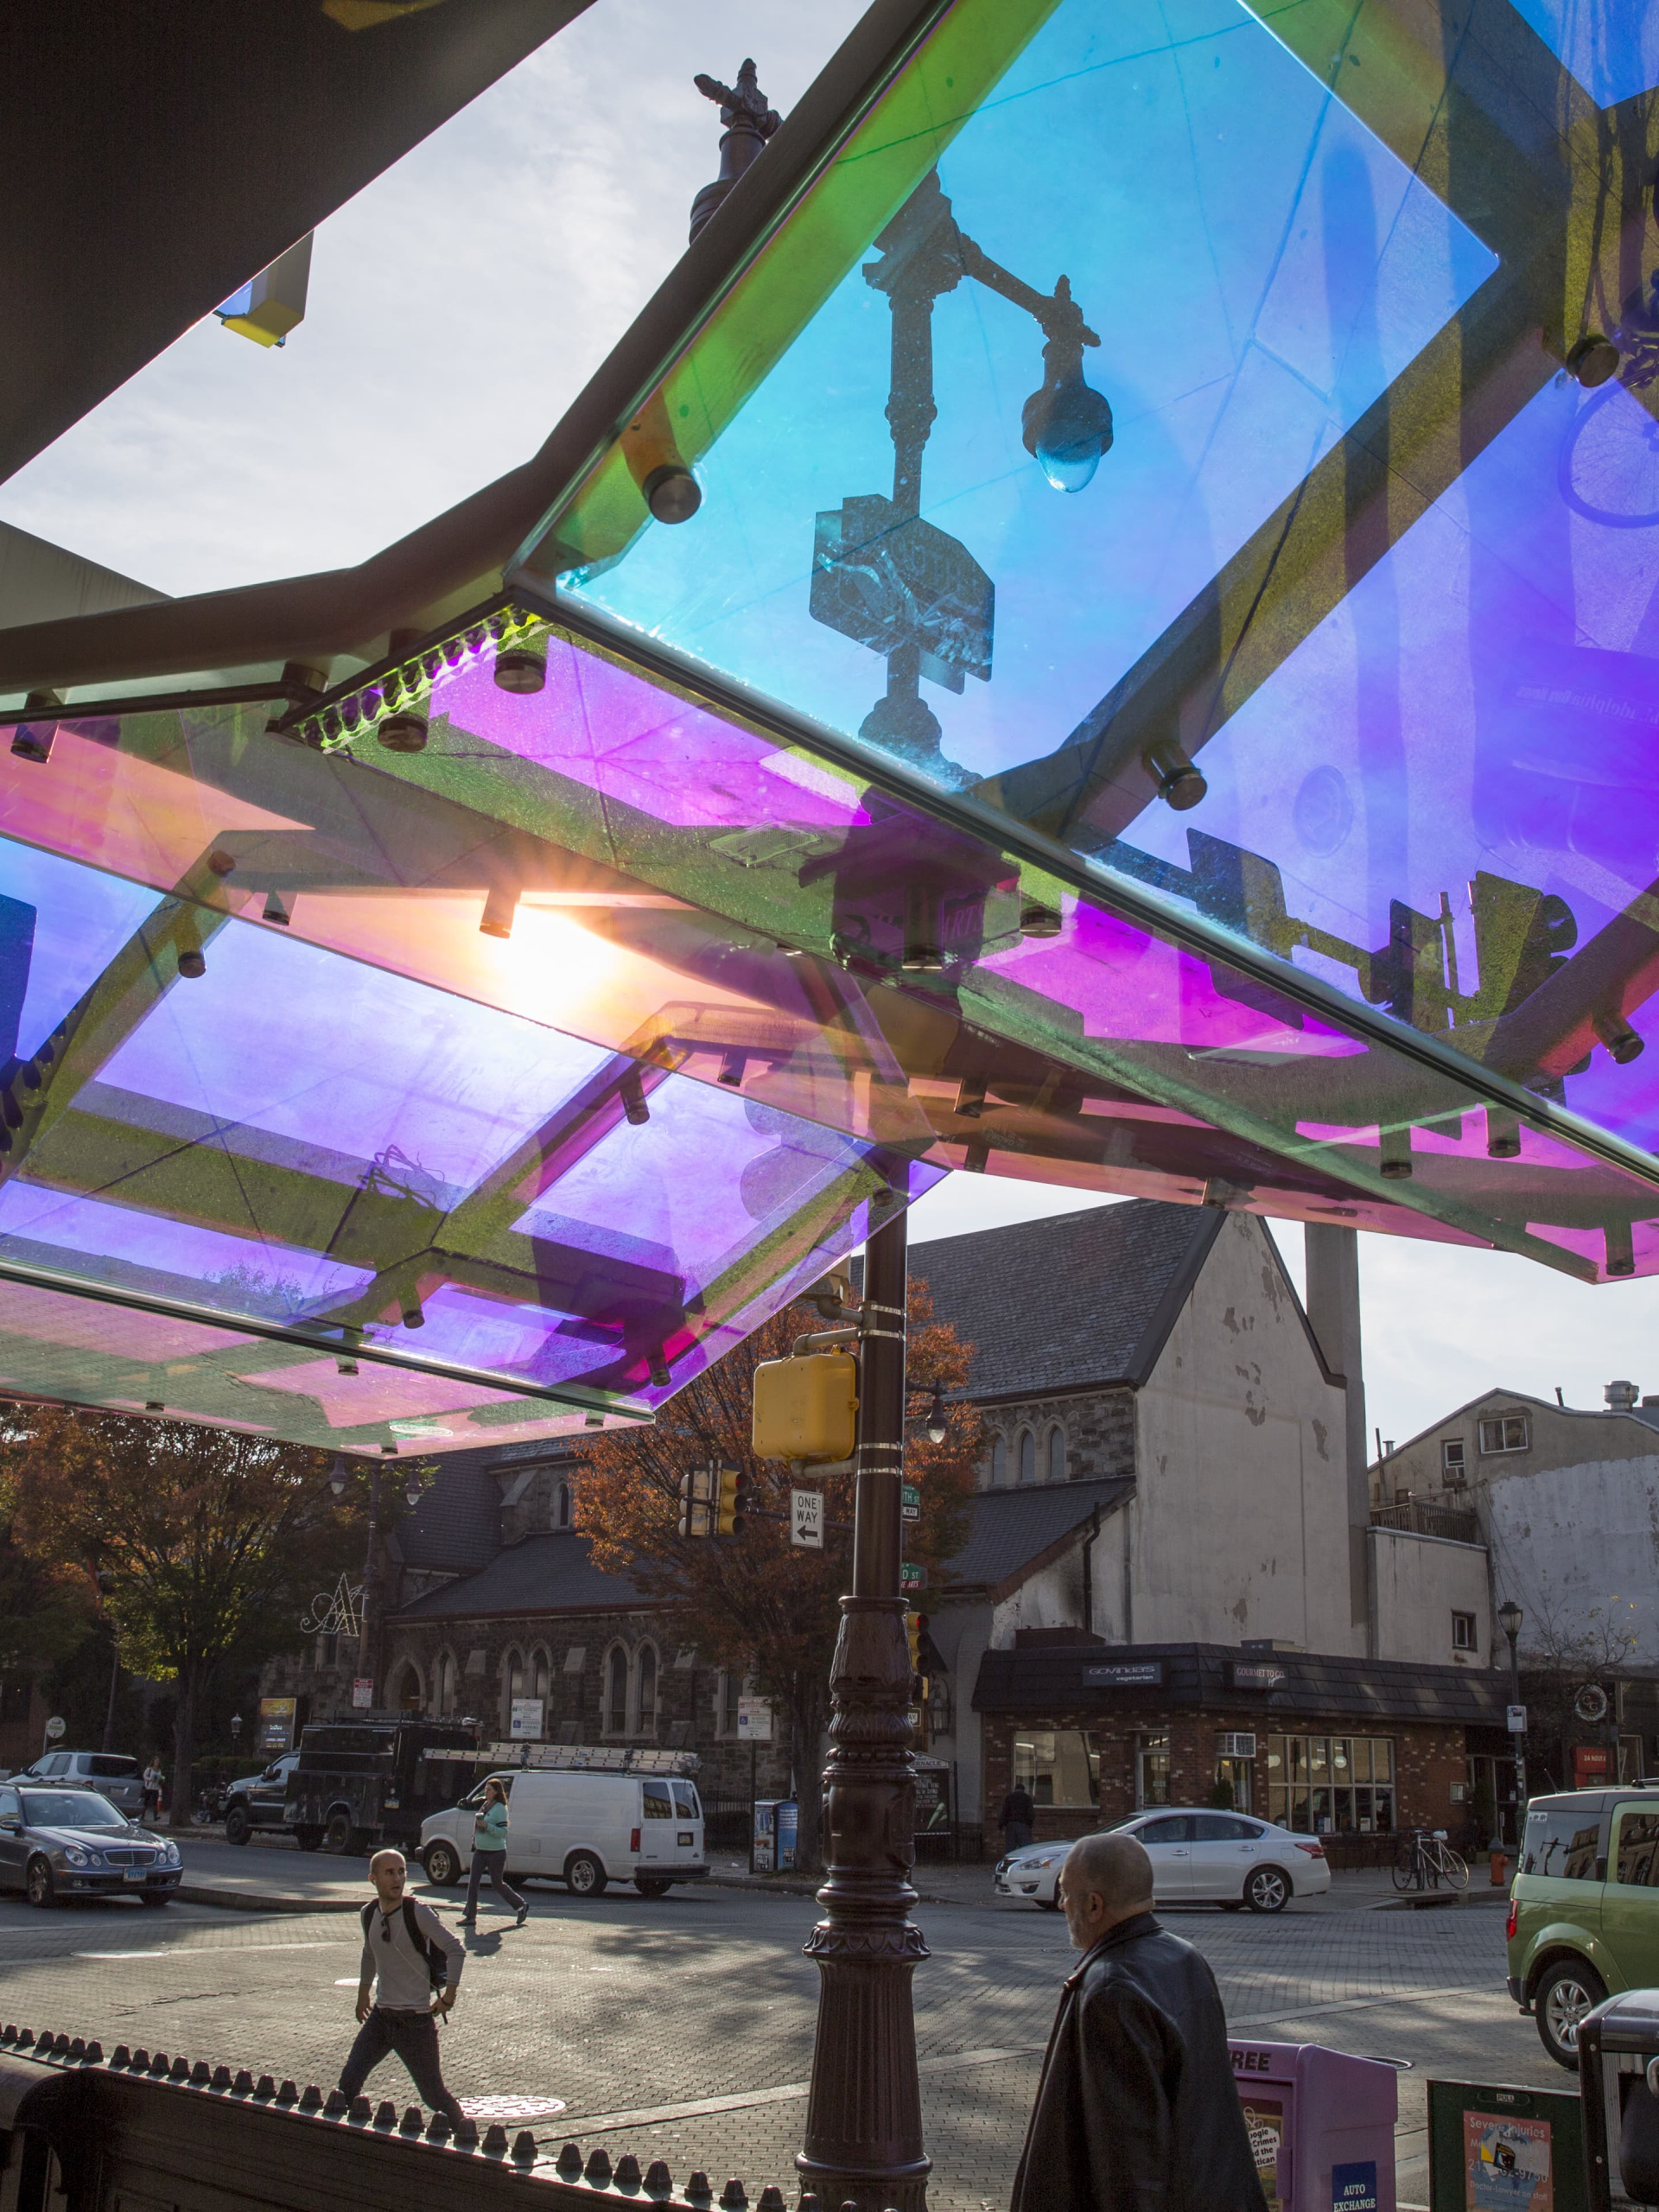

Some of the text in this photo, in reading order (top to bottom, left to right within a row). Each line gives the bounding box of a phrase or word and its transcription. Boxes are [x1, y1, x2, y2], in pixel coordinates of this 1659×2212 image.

[798, 1496, 817, 1510] ONE
[902, 1491, 912, 1503] TH
[797, 1510, 817, 1523] WAY
[1236, 1667, 1265, 1677] GOURMET
[1266, 1669, 1274, 1678] TO
[1229, 2050, 1271, 2071] REE
[1497, 2094, 1514, 2102] PULL
[1470, 2117, 1545, 2139] Severe Injuries
[1252, 2137, 1277, 2148] Crimes
[1261, 2146, 1274, 2156] the
[1344, 2183, 1365, 2196] AUTO
[1470, 2180, 1521, 2197] Doctor-Lawyer
[1333, 2197, 1376, 2212] EXCHANGE
